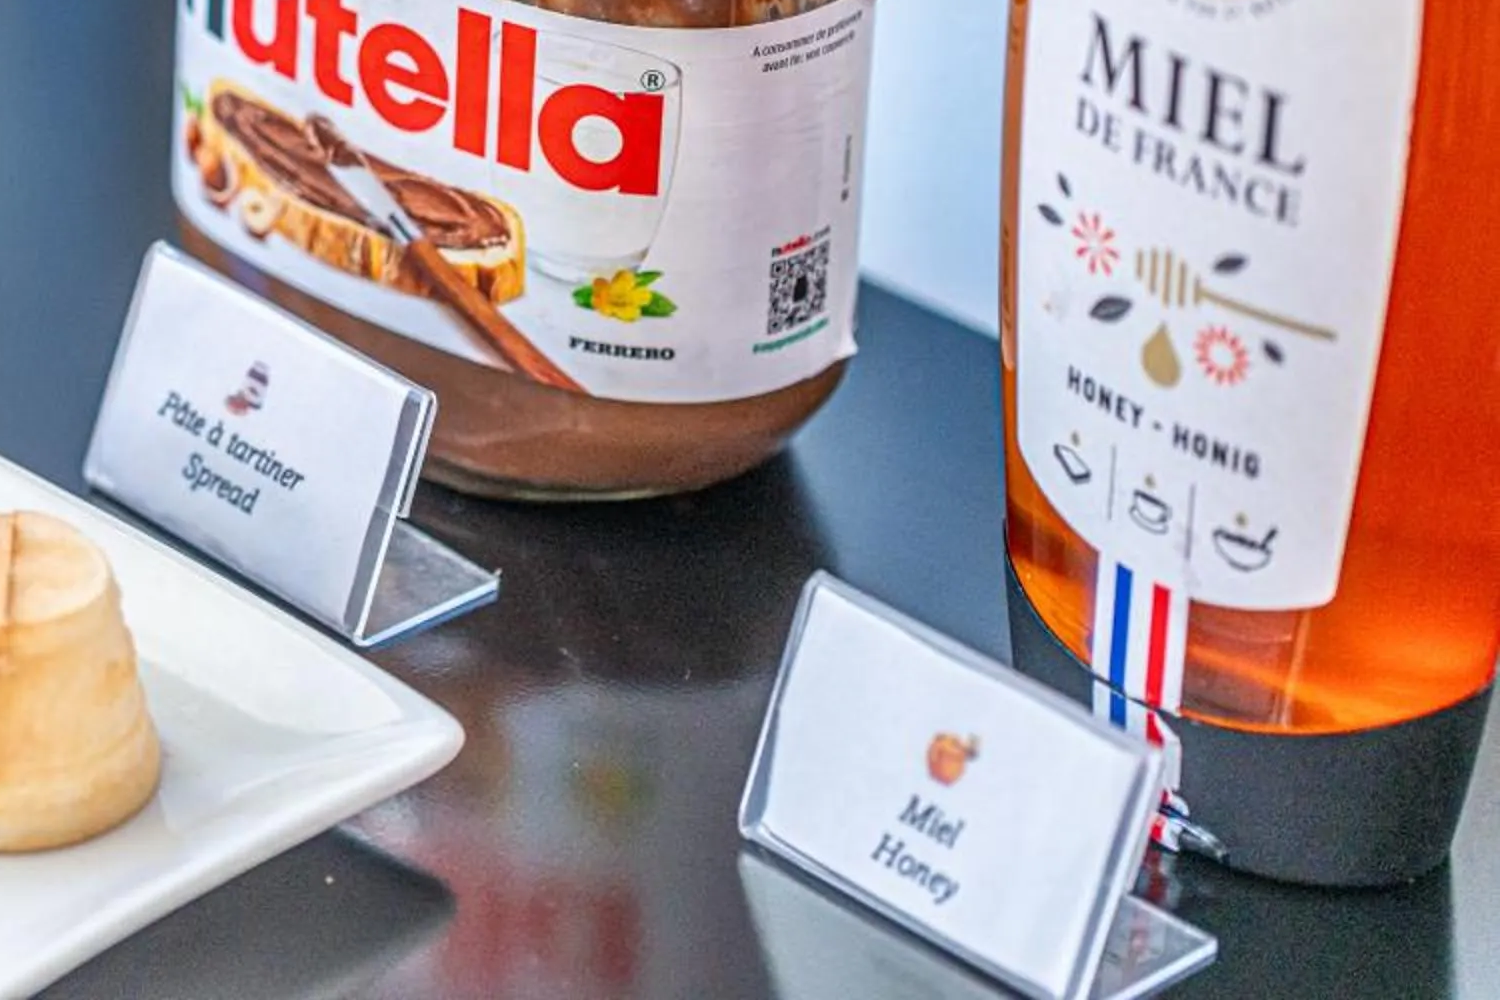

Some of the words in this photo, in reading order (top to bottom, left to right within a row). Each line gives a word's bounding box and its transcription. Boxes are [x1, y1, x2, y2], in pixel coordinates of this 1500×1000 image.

[1079, 11, 1308, 177] MIEL
[1074, 96, 1124, 154] DE
[1132, 132, 1305, 228] FRANCE
[567, 335, 677, 361] FERRERO
[156, 390, 207, 438] Pâte
[206, 419, 225, 448] à
[225, 432, 305, 492] tartiner
[1066, 366, 1147, 430] HONEY
[1170, 422, 1263, 479] HONIG
[181, 450, 261, 516] Spread
[897, 792, 966, 850] Miel
[870, 831, 961, 906] Honey
